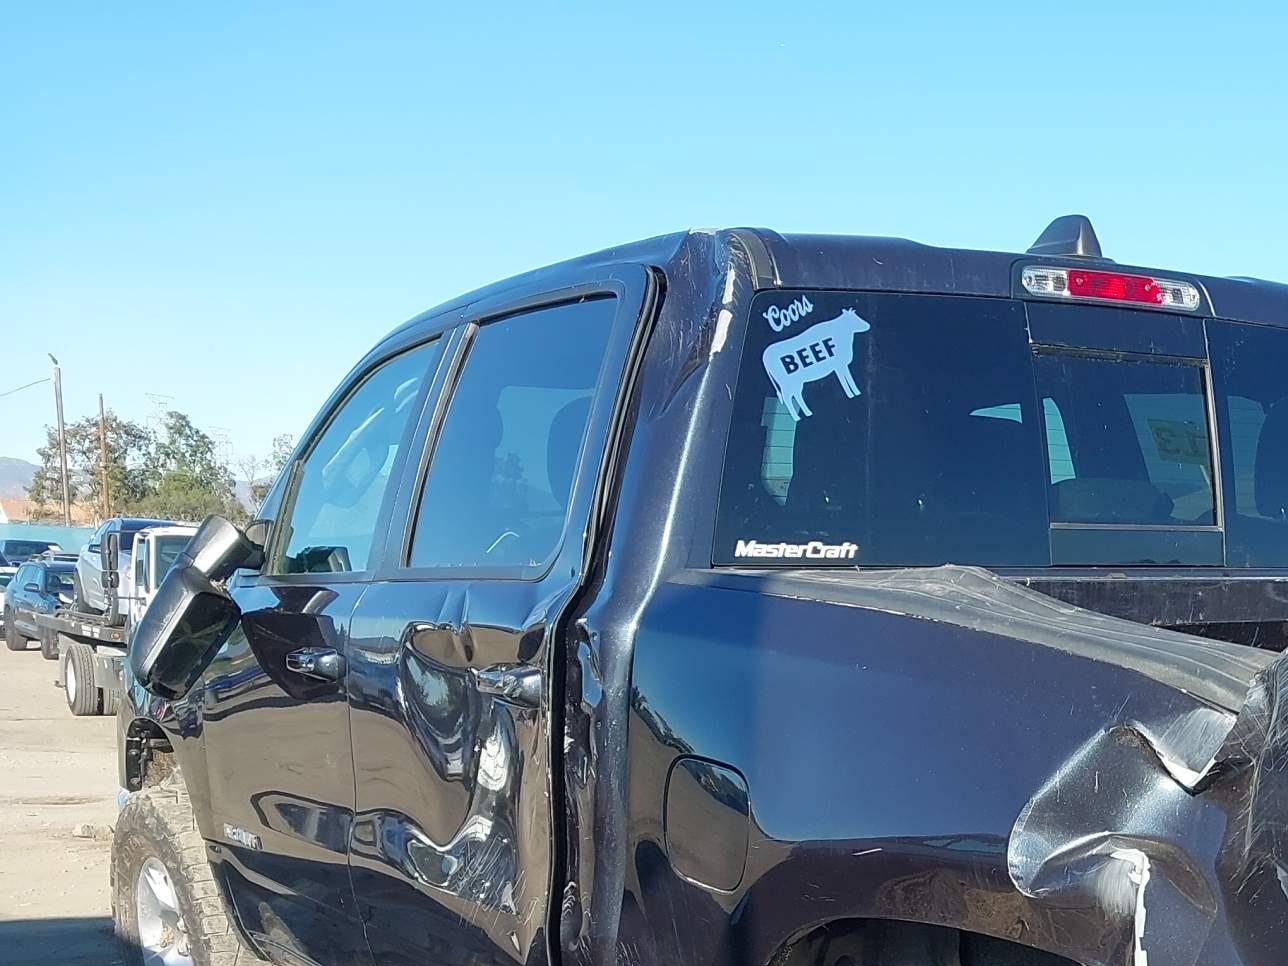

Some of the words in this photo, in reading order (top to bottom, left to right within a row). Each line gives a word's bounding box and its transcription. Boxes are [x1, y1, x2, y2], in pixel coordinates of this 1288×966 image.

[762, 295, 814, 333] Coors
[780, 337, 837, 375] BEEF
[734, 540, 858, 559] MasterCraft
